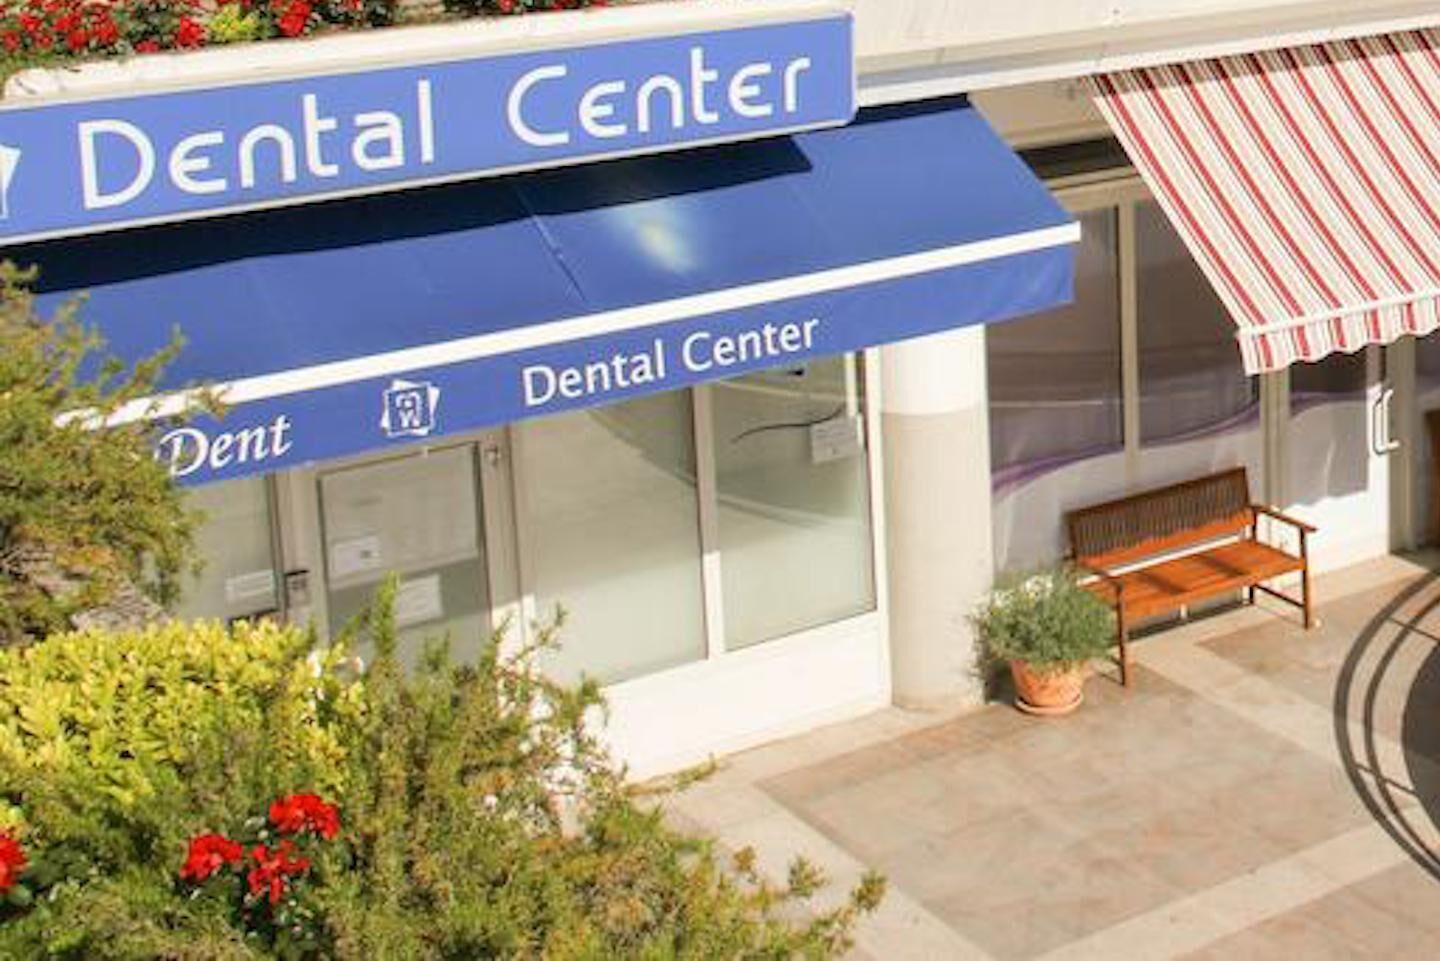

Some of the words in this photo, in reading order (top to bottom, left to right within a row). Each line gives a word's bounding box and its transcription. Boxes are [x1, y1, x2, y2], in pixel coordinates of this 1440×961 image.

[78, 77, 436, 210] Dental
[507, 46, 811, 147] Center
[522, 339, 665, 407] Dental
[682, 318, 819, 372] Center
